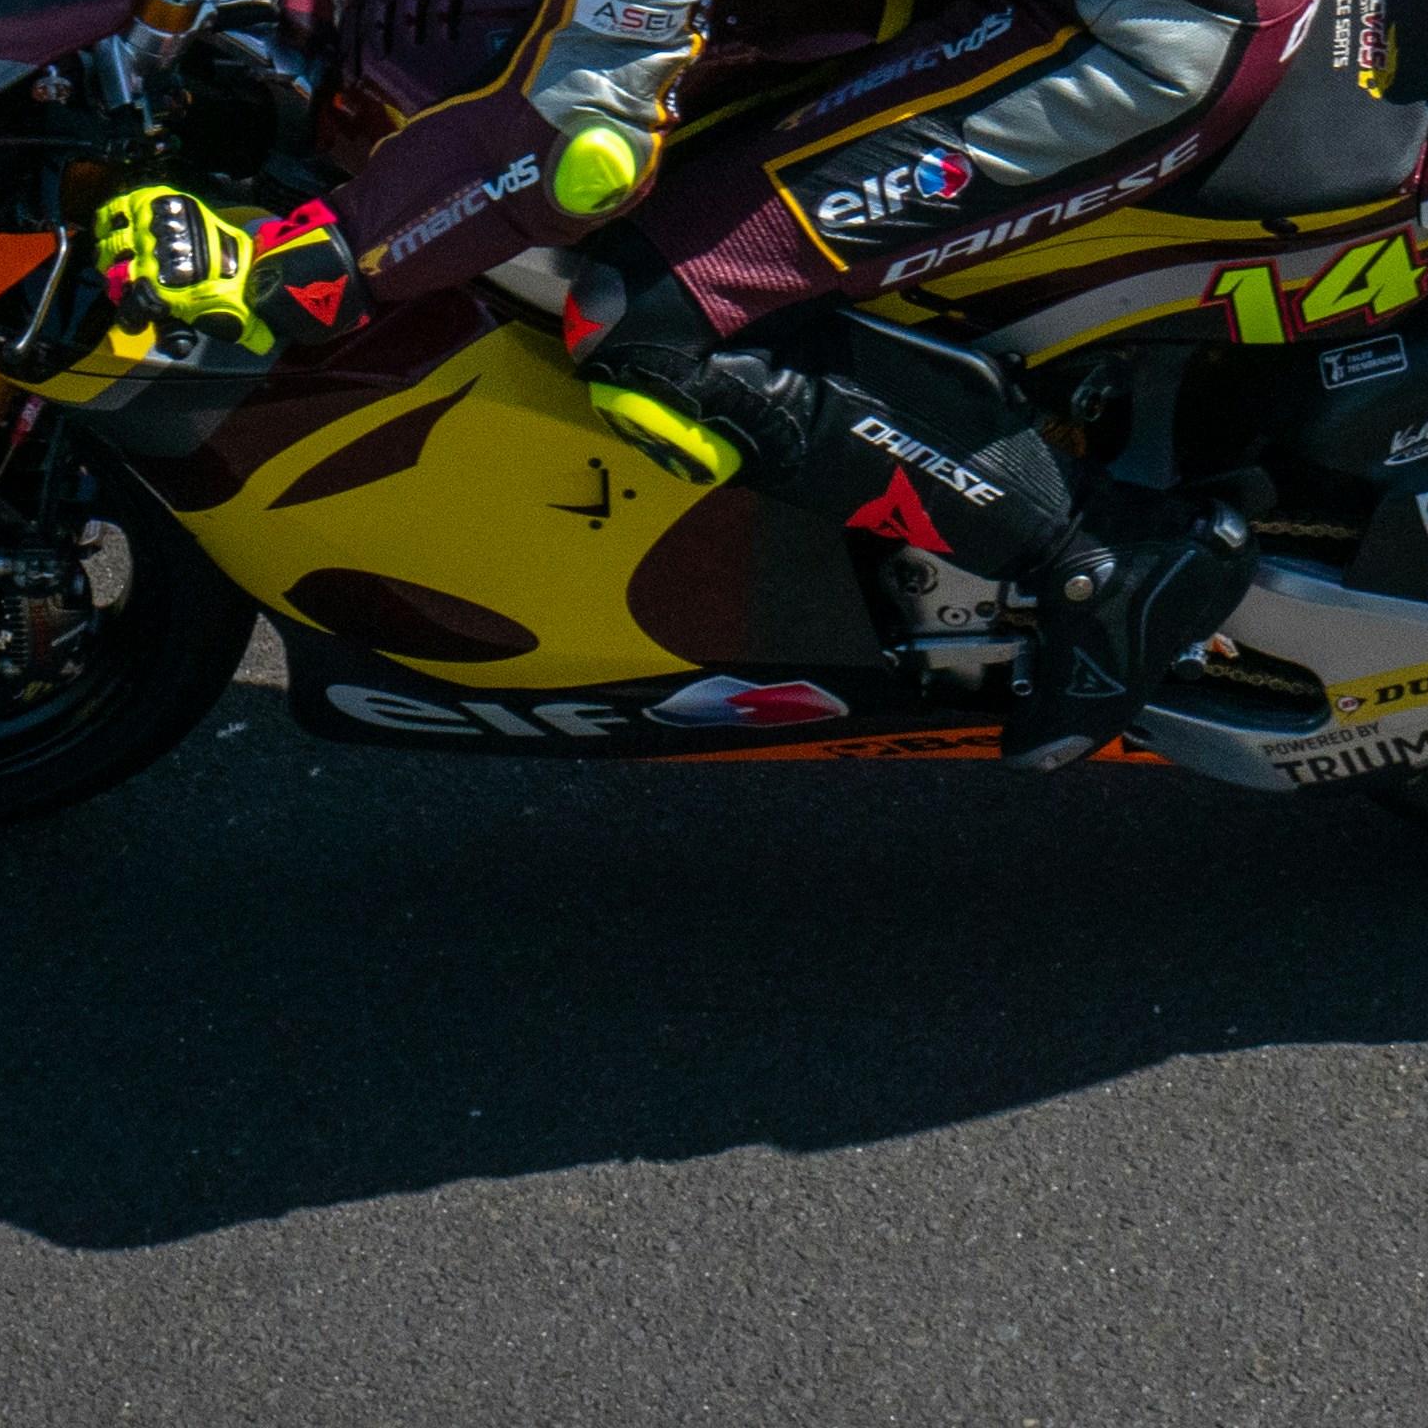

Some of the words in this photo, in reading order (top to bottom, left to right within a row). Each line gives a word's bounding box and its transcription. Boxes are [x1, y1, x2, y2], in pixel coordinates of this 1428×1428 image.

[1333, 18, 1351, 69] SEATS
[818, 166, 913, 229] elf
[881, 133, 1200, 287] DAINESE
[850, 415, 1005, 506] DAINESE
[326, 683, 635, 738] elf
[1263, 726, 1354, 757] POWERED
[1356, 721, 1380, 741] BY
